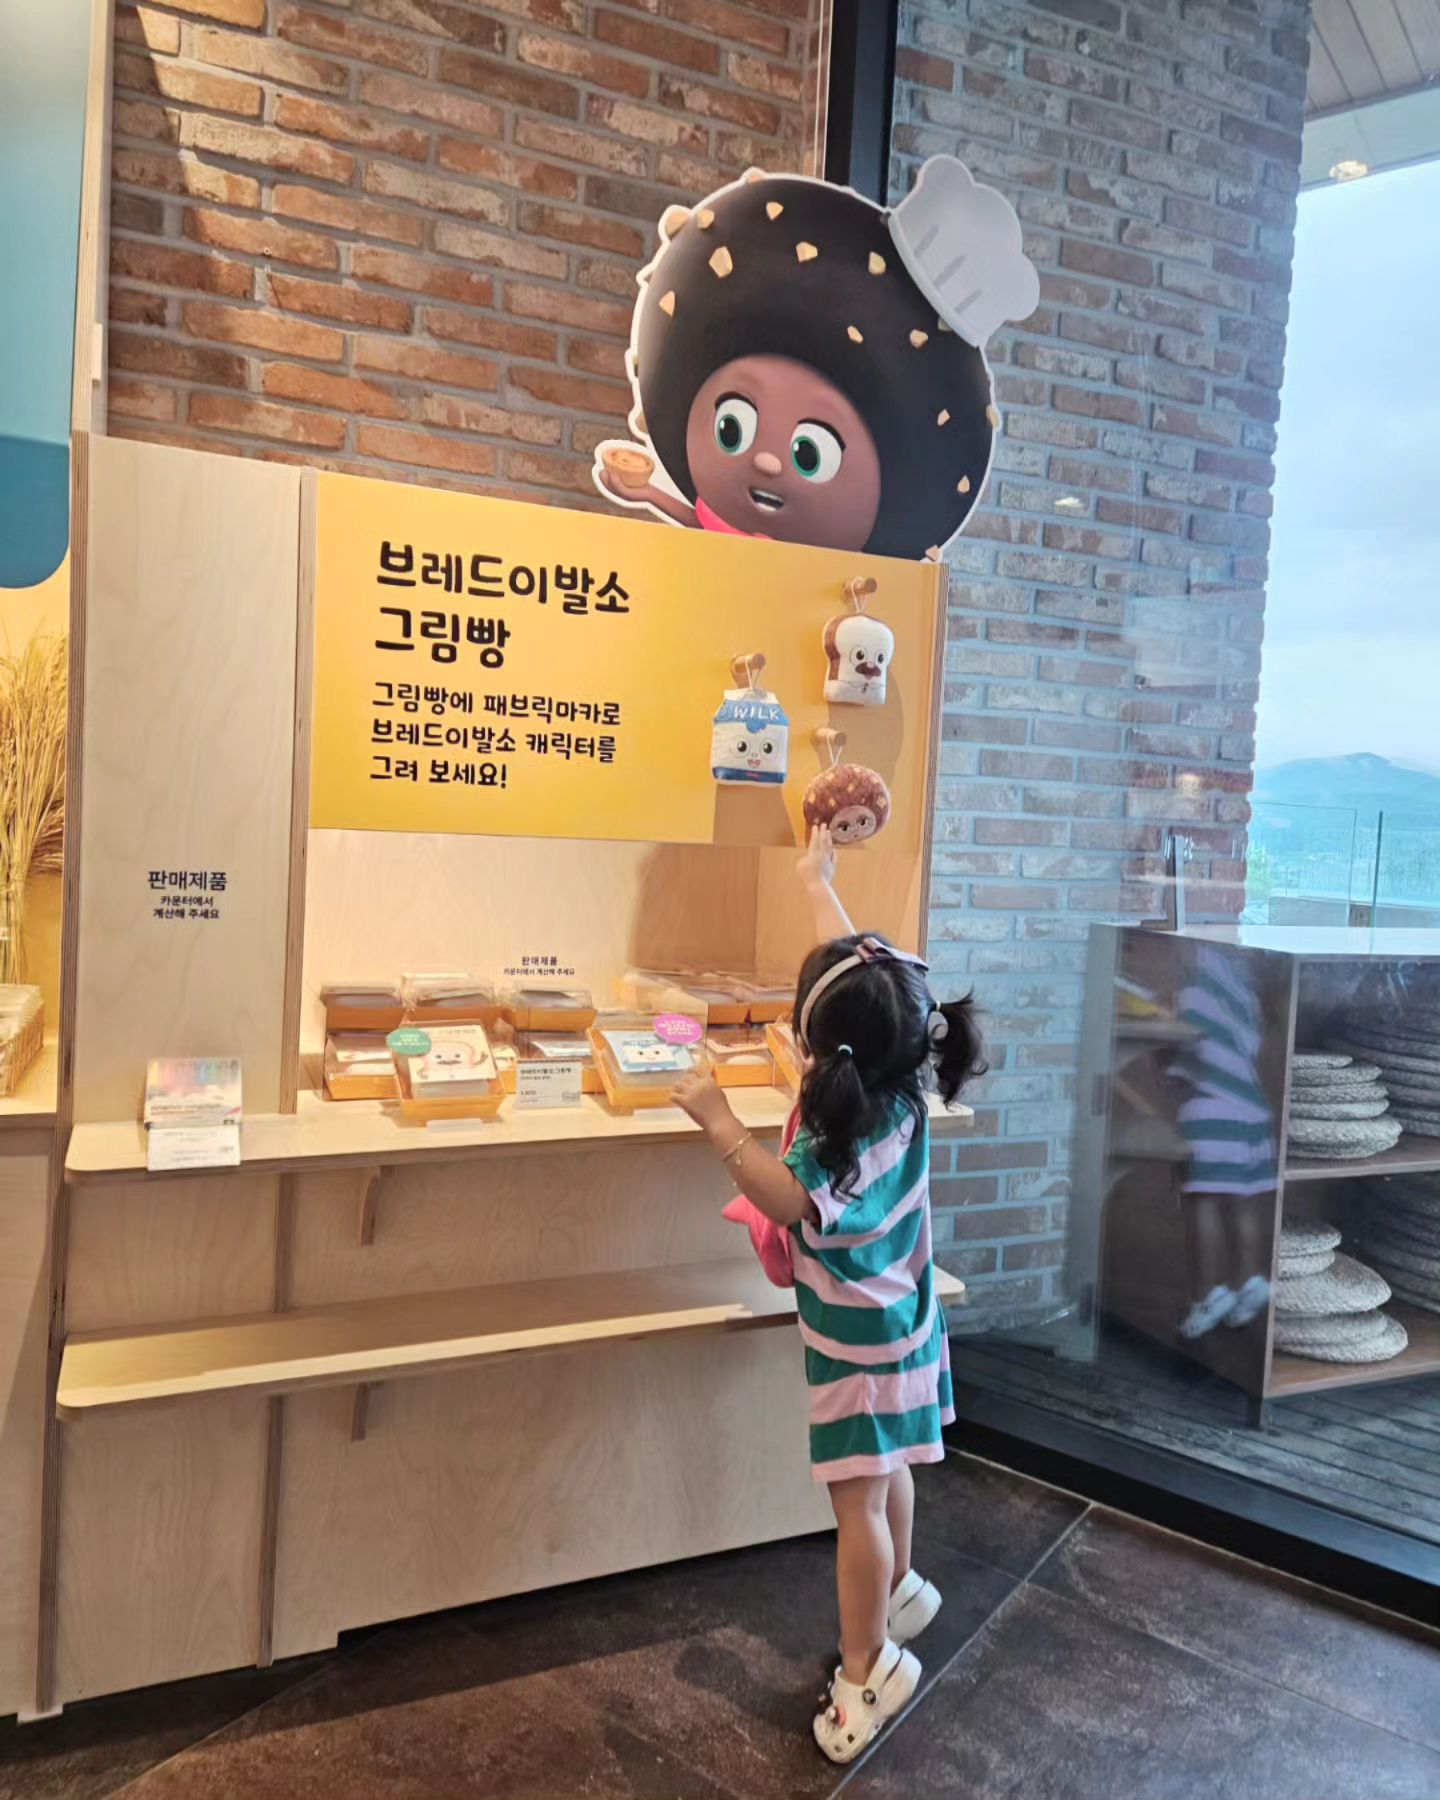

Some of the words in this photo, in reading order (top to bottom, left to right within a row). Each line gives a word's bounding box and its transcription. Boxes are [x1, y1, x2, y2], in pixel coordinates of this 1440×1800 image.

[377, 541, 630, 616] 브레드이발소
[375, 607, 511, 668] 그림빵
[372, 682, 473, 715] 그림빵에
[484, 694, 621, 726] 패브릭마카로
[733, 705, 779, 720] WILK
[371, 719, 516, 754] 브레드이발소
[525, 732, 616, 763] 캐릭터를
[370, 756, 418, 781] 그려
[429, 759, 507, 788] 보세요!
[148, 870, 227, 891] 판매제품
[153, 908, 185, 919] 계산해
[188, 908, 220, 919] 주세요
[161, 895, 214, 907] 카운터에서
